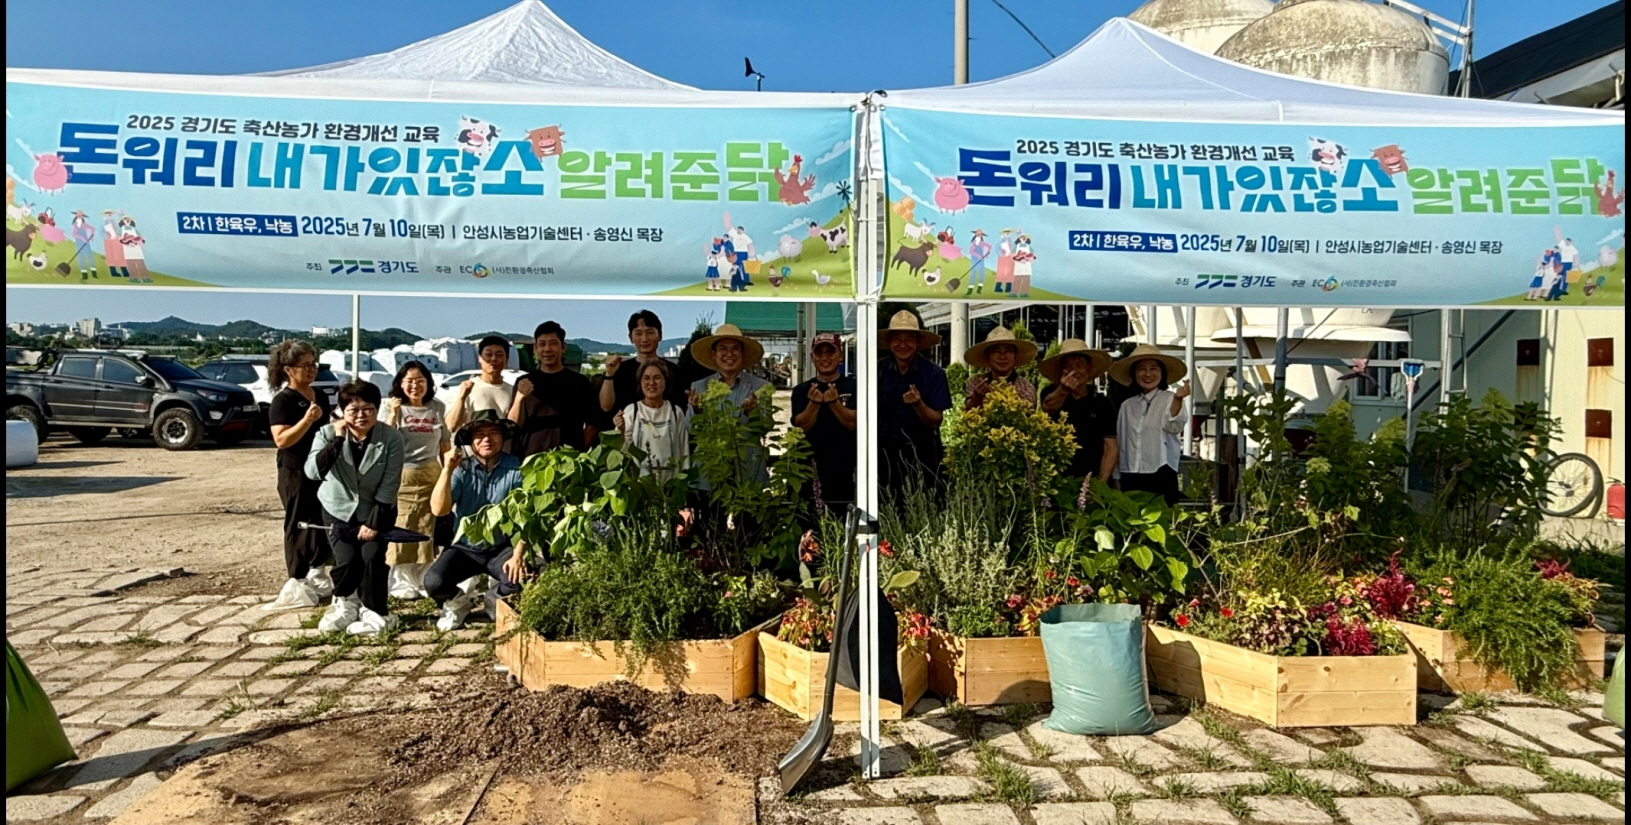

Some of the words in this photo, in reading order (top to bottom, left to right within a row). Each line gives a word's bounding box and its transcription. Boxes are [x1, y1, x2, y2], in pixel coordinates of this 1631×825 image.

[126, 114, 175, 131] 2025
[181, 116, 237, 135] 경기도
[242, 119, 319, 139] 축산농가
[323, 123, 398, 142] 환경개선
[403, 126, 440, 143] 교육
[1016, 139, 1060, 155] 2025
[1064, 141, 1115, 158] 경기도
[1119, 143, 1187, 160] 축산농가
[1190, 144, 1257, 161] 환경개선
[1261, 146, 1295, 162] 교육
[57, 122, 238, 188] 돈워리
[247, 140, 544, 197] 내가있잖소
[557, 142, 790, 202] 알려준닭
[957, 148, 1122, 209] 돈워리
[1130, 158, 1399, 213] 내가있잖소
[1406, 158, 1605, 216] 알려준닭
[182, 215, 205, 231] 2차
[215, 217, 262, 234] 한육우,
[265, 218, 293, 234] 낙농
[301, 216, 359, 237] 2025년
[362, 218, 386, 238] 7월
[389, 219, 445, 239] 10일(목)
[463, 225, 583, 240] 안성시농업기술센터
[593, 227, 633, 241] 송영신
[636, 227, 664, 242] 목장
[1073, 233, 1094, 248] 2차
[1103, 234, 1146, 250] 한육우,
[1149, 235, 1174, 250] 낙농
[1180, 234, 1232, 251] 2025년
[1236, 235, 1257, 252] 7월
[1261, 235, 1310, 253] 10일(목)
[1325, 239, 1432, 254] 안성시농업기술센터
[1441, 241, 1476, 254] 송영신
[1479, 241, 1503, 254] 목장
[305, 262, 323, 271] 주최
[377, 260, 419, 273] 경기도
[435, 266, 451, 274] 주관
[1174, 277, 1190, 286] 주최
[1240, 275, 1277, 288] 경기도
[1290, 279, 1306, 288] 주관
